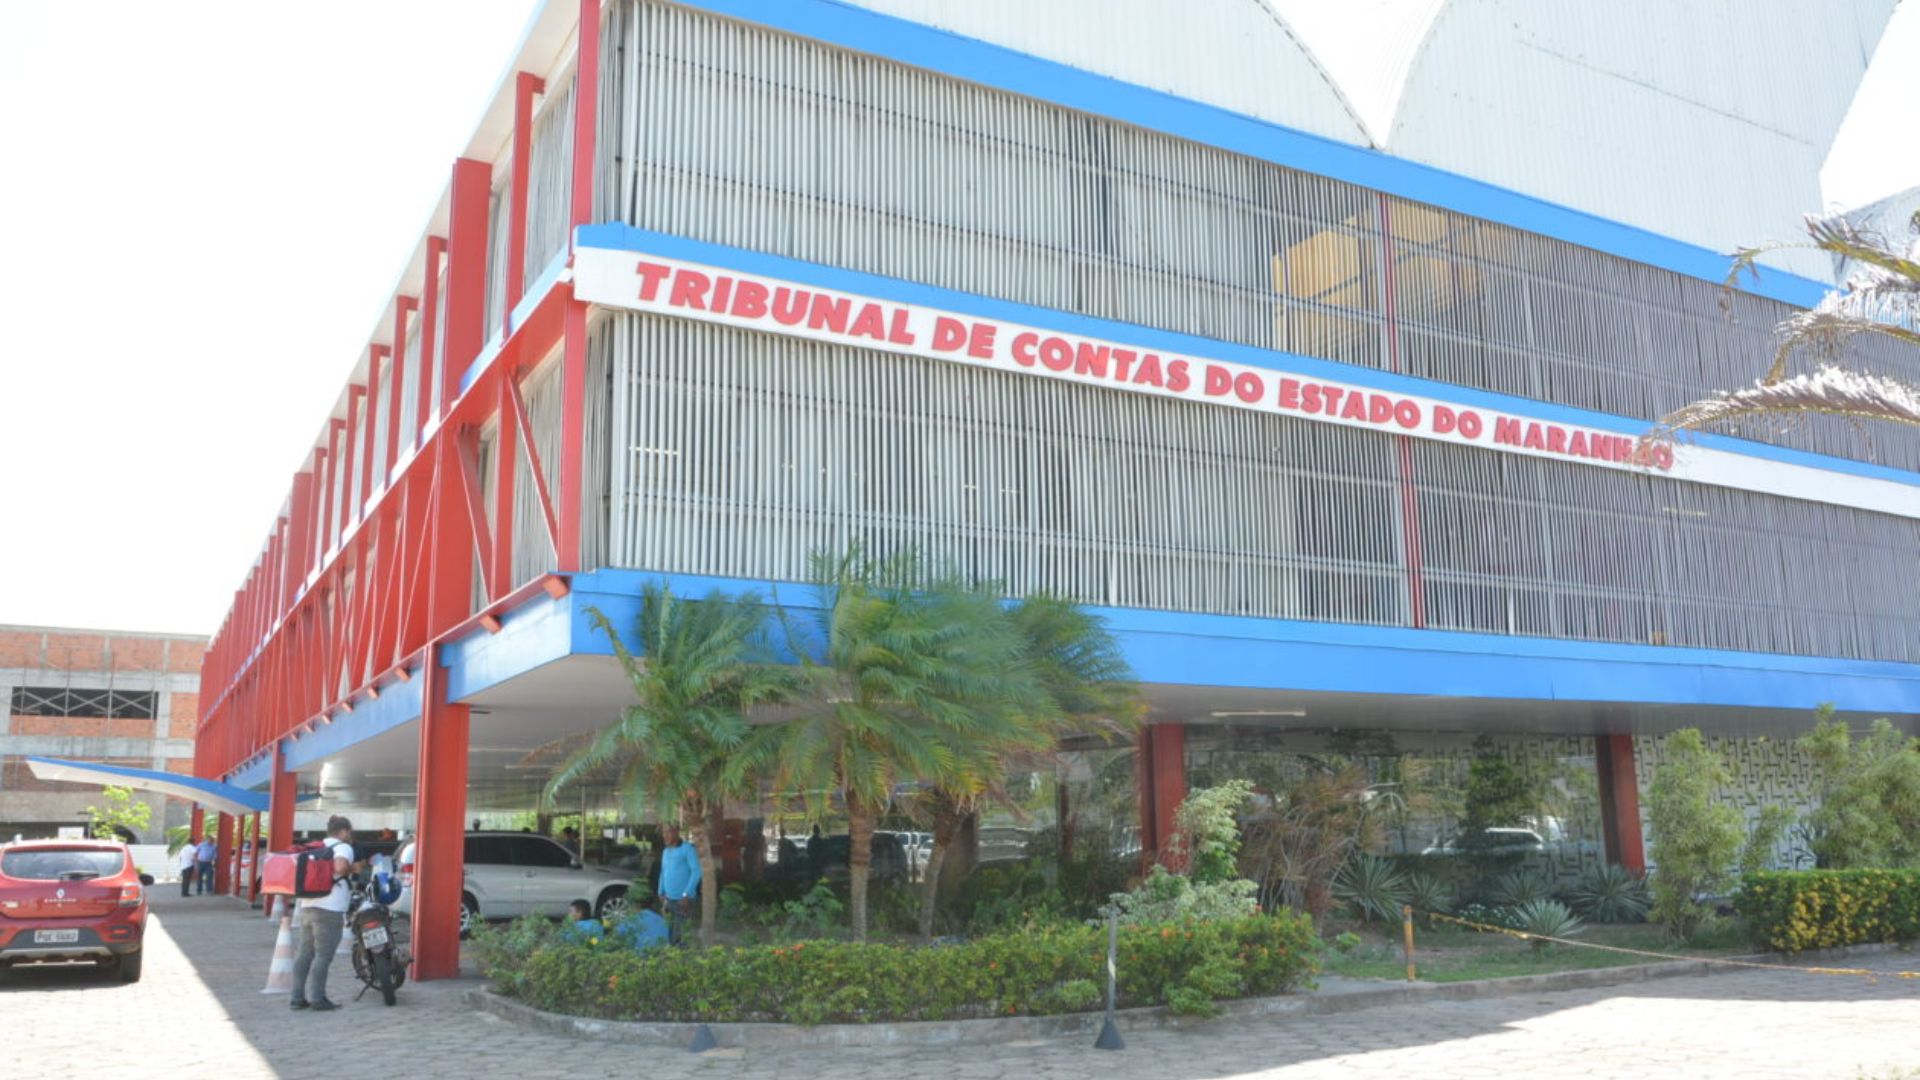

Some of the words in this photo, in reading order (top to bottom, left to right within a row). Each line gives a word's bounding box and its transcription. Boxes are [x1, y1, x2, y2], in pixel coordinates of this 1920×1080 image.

[637, 262, 915, 345] TRIBUNAL
[933, 317, 998, 358] DE
[1012, 333, 1190, 392] CONTAS
[1206, 366, 1265, 403] DO
[1279, 380, 1421, 428] ESTADO
[1434, 406, 1482, 438] DO
